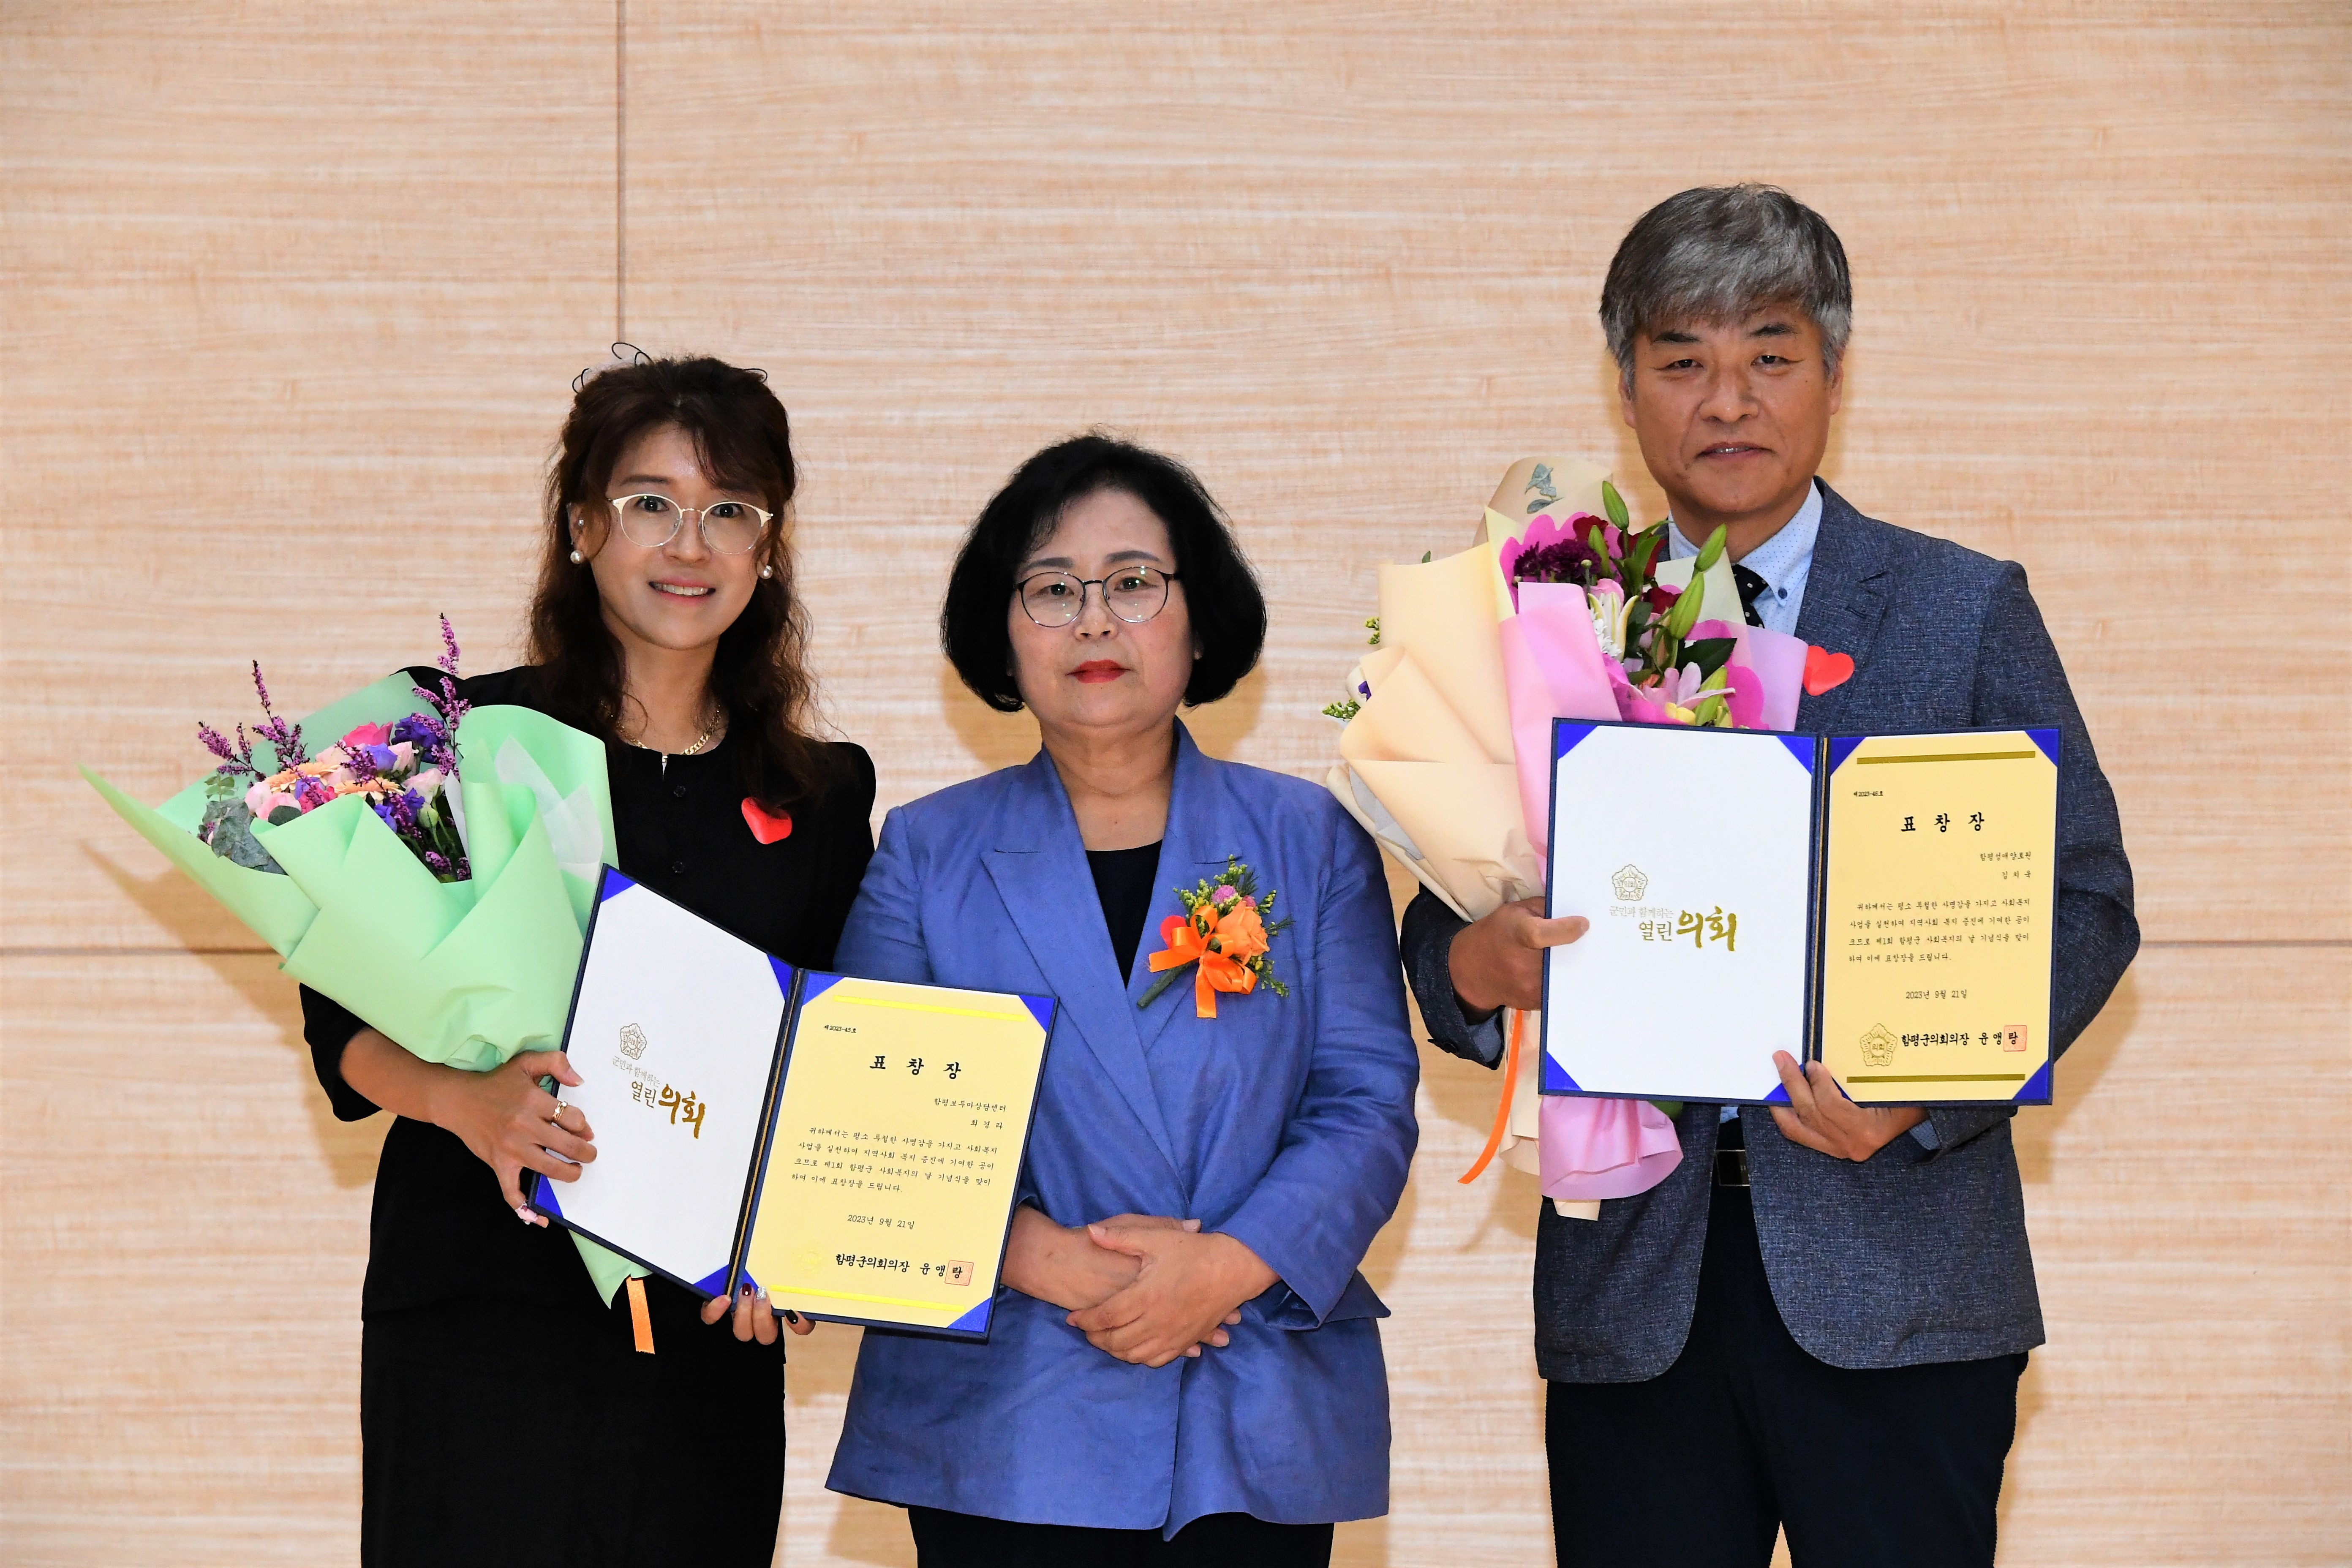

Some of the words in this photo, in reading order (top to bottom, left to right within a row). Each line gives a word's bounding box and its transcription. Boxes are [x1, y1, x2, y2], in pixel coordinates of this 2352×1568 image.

[1857, 903, 1893, 911] 귀하께서는
[1898, 902, 1911, 911] 평소
[1916, 901, 1938, 910] 투철한
[1942, 900, 1971, 909] 사명감을
[1639, 920, 1672, 942] 열린
[1676, 906, 1737, 952] 의회
[1850, 920, 1871, 929] 사업을
[1876, 920, 1904, 928] 실천하여
[1910, 918, 1938, 926] 지역사회
[1963, 917, 1983, 926] 증진에
[1989, 916, 2011, 925] 기여한
[2015, 916, 2029, 924] 공이
[1900, 936, 1920, 945] 함평군
[1926, 935, 1962, 943] 사회복지의
[1968, 935, 1975, 943] 날
[1981, 934, 2009, 942] 기념식을
[2015, 933, 2028, 941] 맞이
[1885, 953, 1914, 962] 표창장을
[1919, 953, 1951, 961] 드립니다.
[1906, 990, 1929, 999] 2023년
[1935, 990, 1946, 999] 9월
[1952, 989, 1967, 999] 21일
[1901, 1033, 1970, 1047] 함평군의회의장
[631, 1081, 657, 1109] 열린
[658, 1083, 706, 1140] 의회
[809, 1127, 848, 1138] 귀하께서는
[902, 1138, 933, 1148] 사명감을
[938, 1141, 961, 1150] 가지고
[966, 1145, 997, 1154] 사회복지
[798, 1142, 821, 1152] 사업을
[827, 1145, 858, 1155] 실천하여
[864, 1149, 895, 1159] 지역사회
[900, 1153, 915, 1162] 복지
[921, 1156, 944, 1165] 증진에
[950, 1159, 973, 1168] 기여한
[979, 1162, 994, 1170] 공이
[824, 1161, 843, 1169] 제1회
[850, 1164, 873, 1173] 함평군
[879, 1167, 917, 1178] 사회복지의
[938, 1173, 969, 1184] 기념식을
[976, 1178, 990, 1186] 맞이
[792, 1173, 806, 1181] 하여
[811, 1176, 826, 1184] 이에
[831, 1179, 863, 1188] 표창장을
[868, 1183, 902, 1192] 드립니다.
[847, 1215, 874, 1225] 2023년
[879, 1218, 892, 1227] 9월
[897, 1220, 914, 1230] 21일
[836, 1253, 910, 1273] 함평군의회의장
